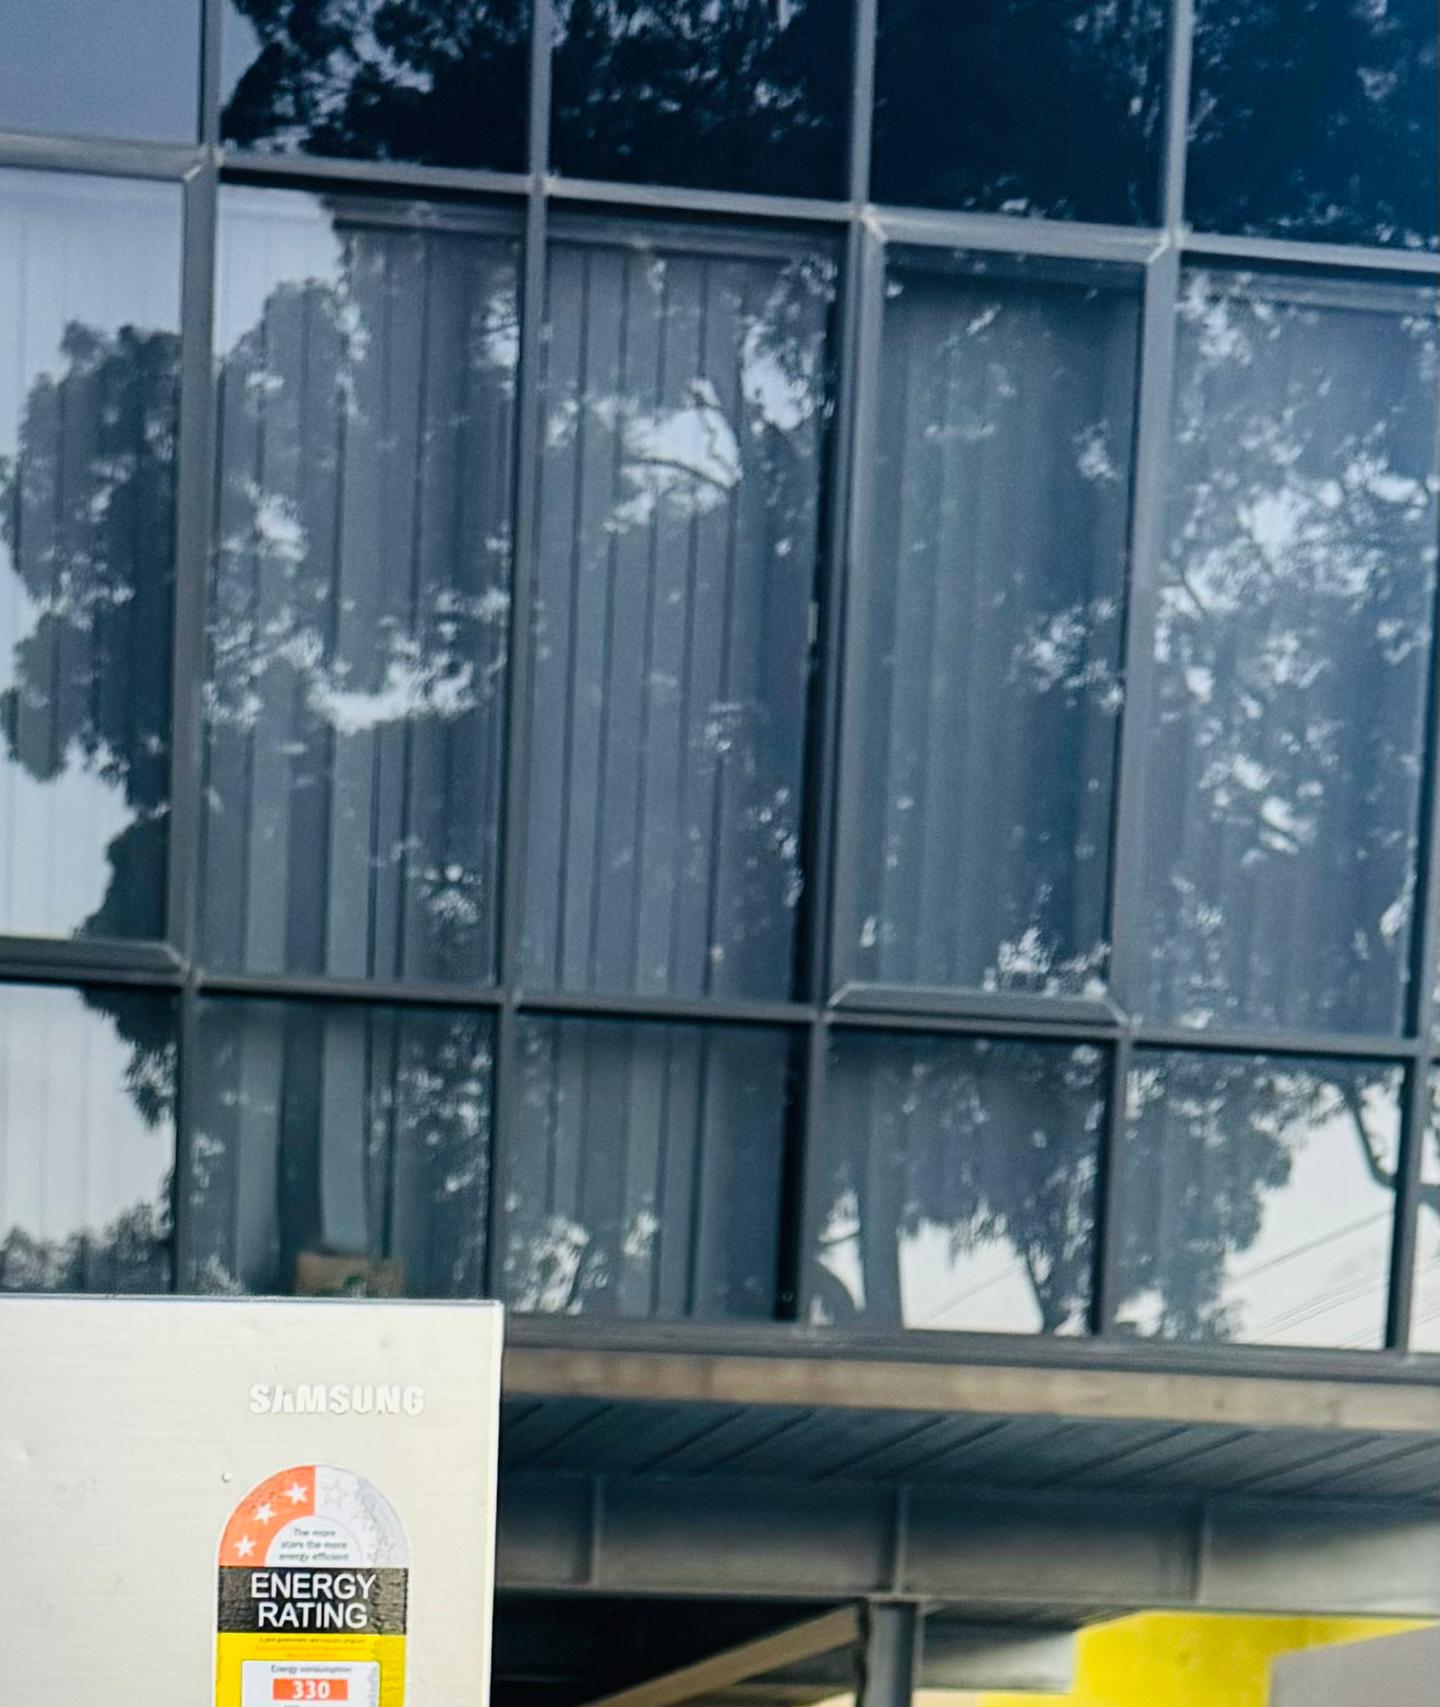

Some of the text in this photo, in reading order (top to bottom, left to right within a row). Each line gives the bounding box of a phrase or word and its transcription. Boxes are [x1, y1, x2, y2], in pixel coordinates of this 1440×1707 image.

[249, 1383, 425, 1416] SAMSUNG
[294, 1528, 310, 1536] The
[306, 1540, 322, 1548] the
[324, 1541, 347, 1549] more
[279, 1553, 309, 1562] energy
[250, 1572, 376, 1600] ENERGY
[258, 1602, 367, 1629] RATING
[271, 1664, 352, 1674] Energy consumption
[292, 1681, 330, 1699] 330
